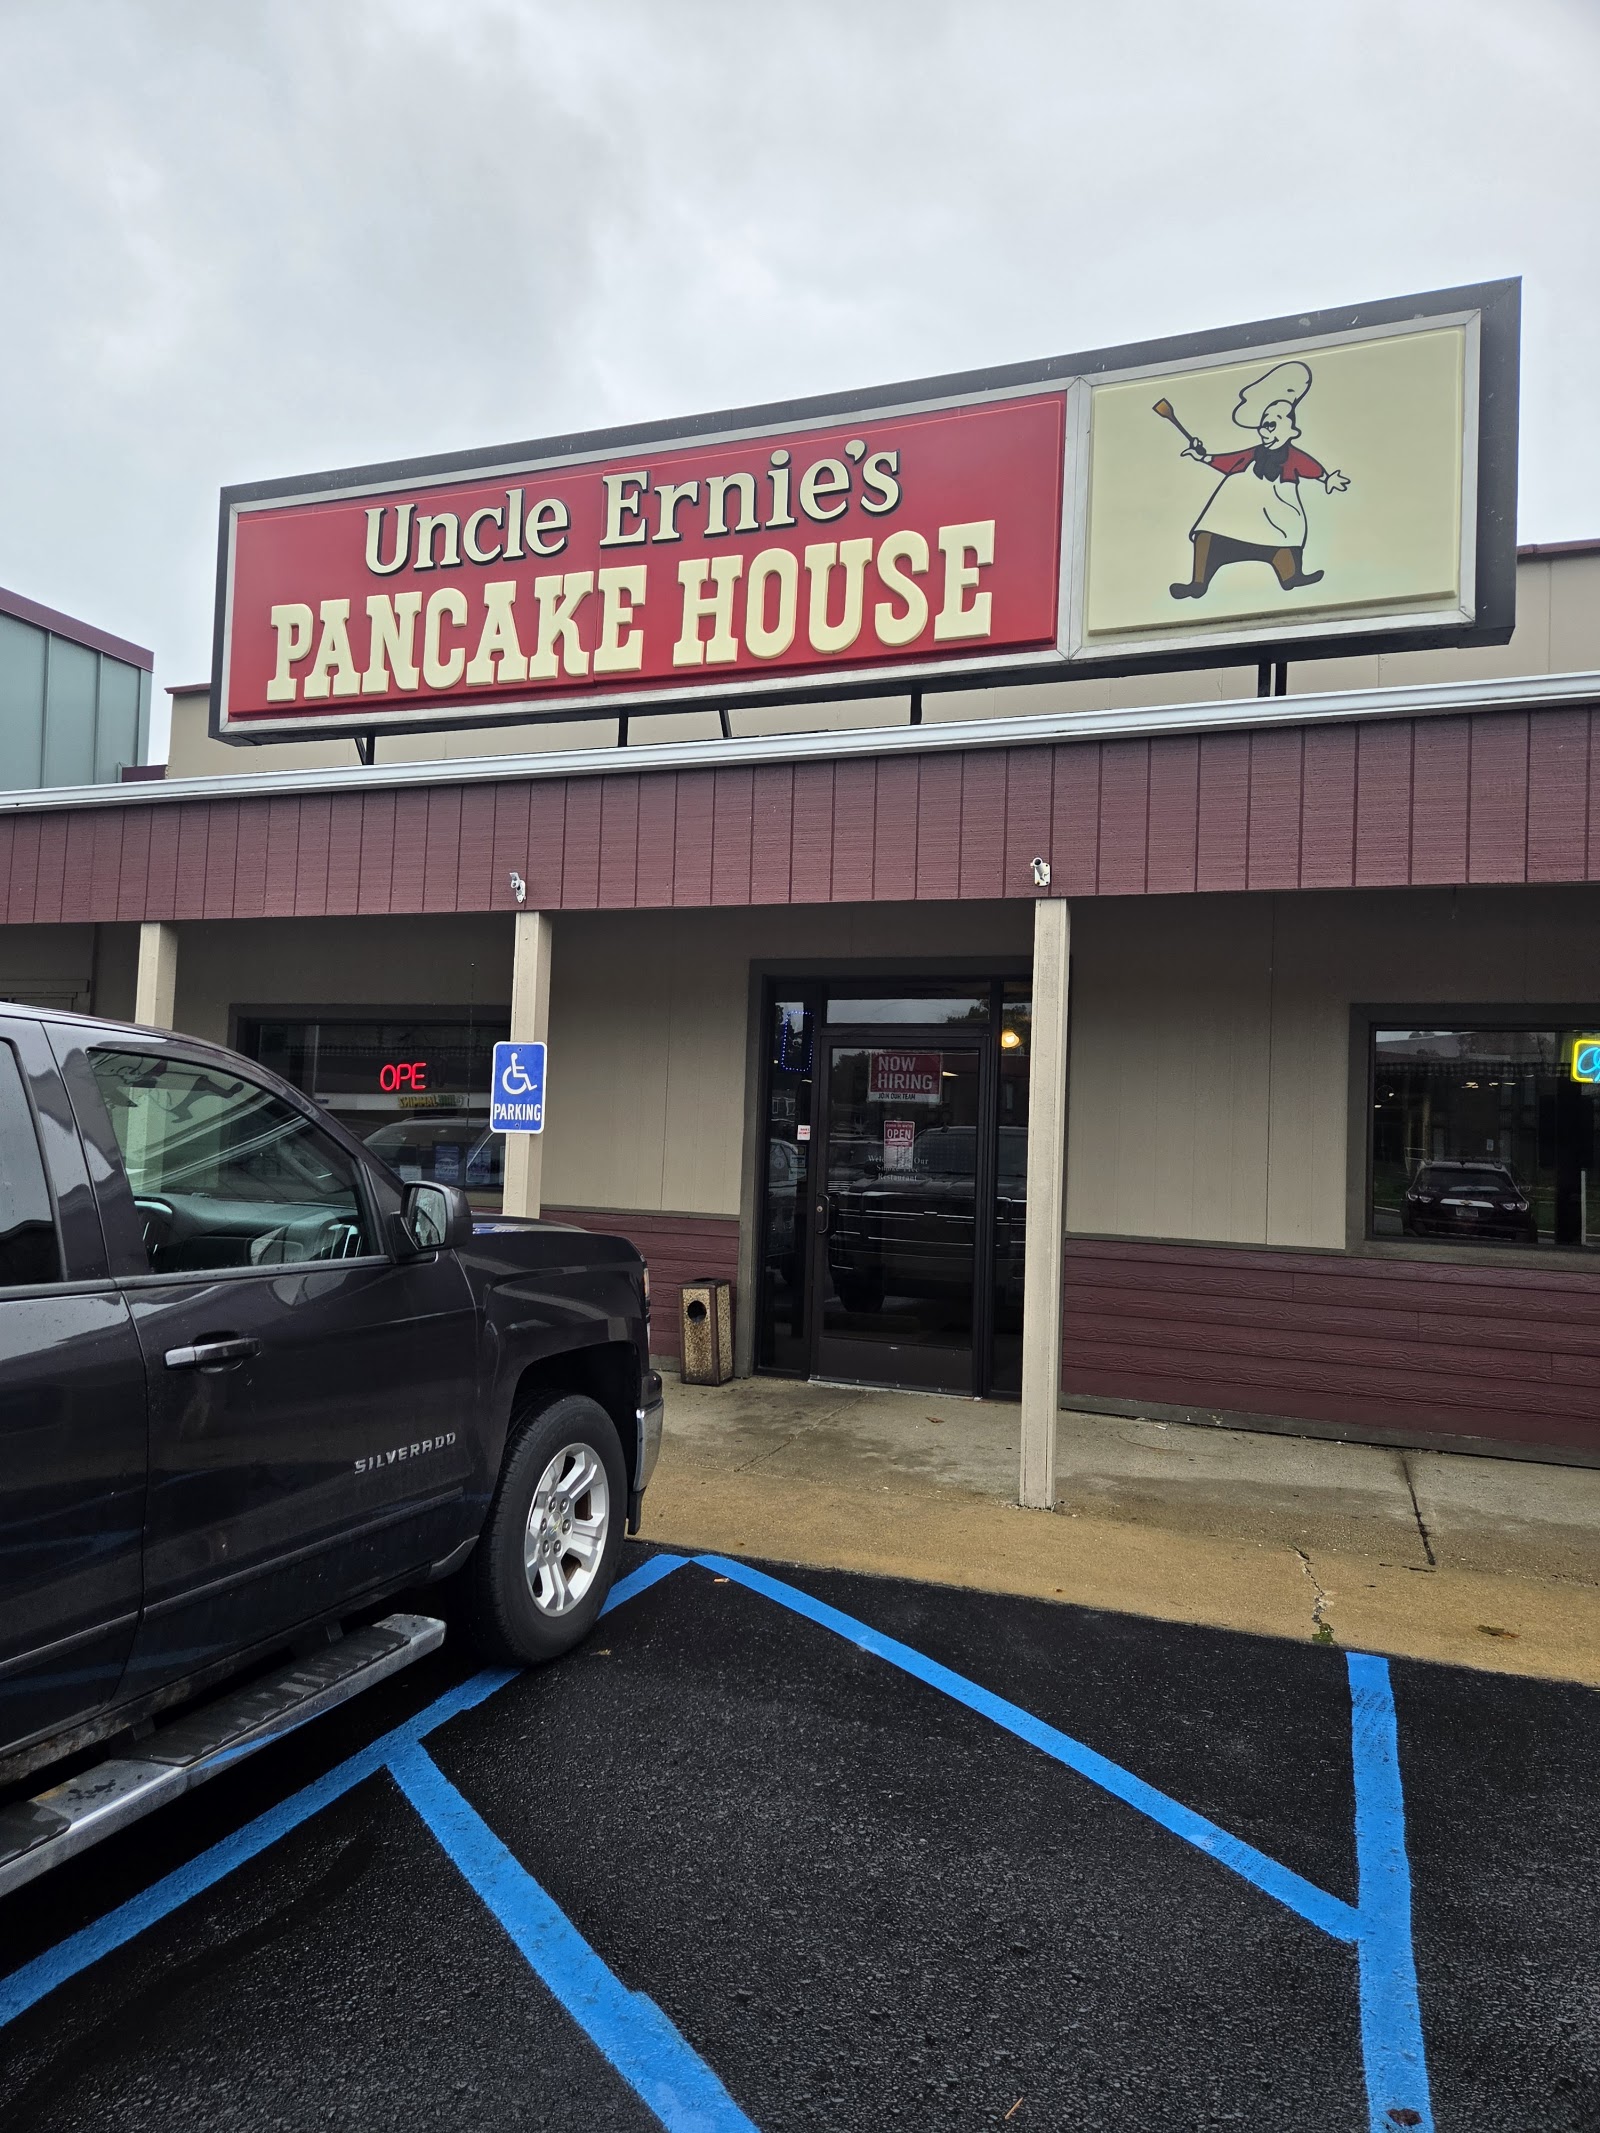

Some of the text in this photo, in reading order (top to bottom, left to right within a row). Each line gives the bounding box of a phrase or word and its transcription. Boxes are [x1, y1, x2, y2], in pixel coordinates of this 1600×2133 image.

[364, 439, 901, 575] Uncle Ernie's
[267, 519, 996, 701] PANCAKE HOUSE
[878, 1056, 916, 1071] NOW
[877, 1073, 933, 1090] HIRING
[493, 1103, 541, 1121] PARKING
[887, 1128, 911, 1140] OPEN
[878, 1173, 917, 1181] Restaurant
[353, 1431, 456, 1475] SILVERADO
